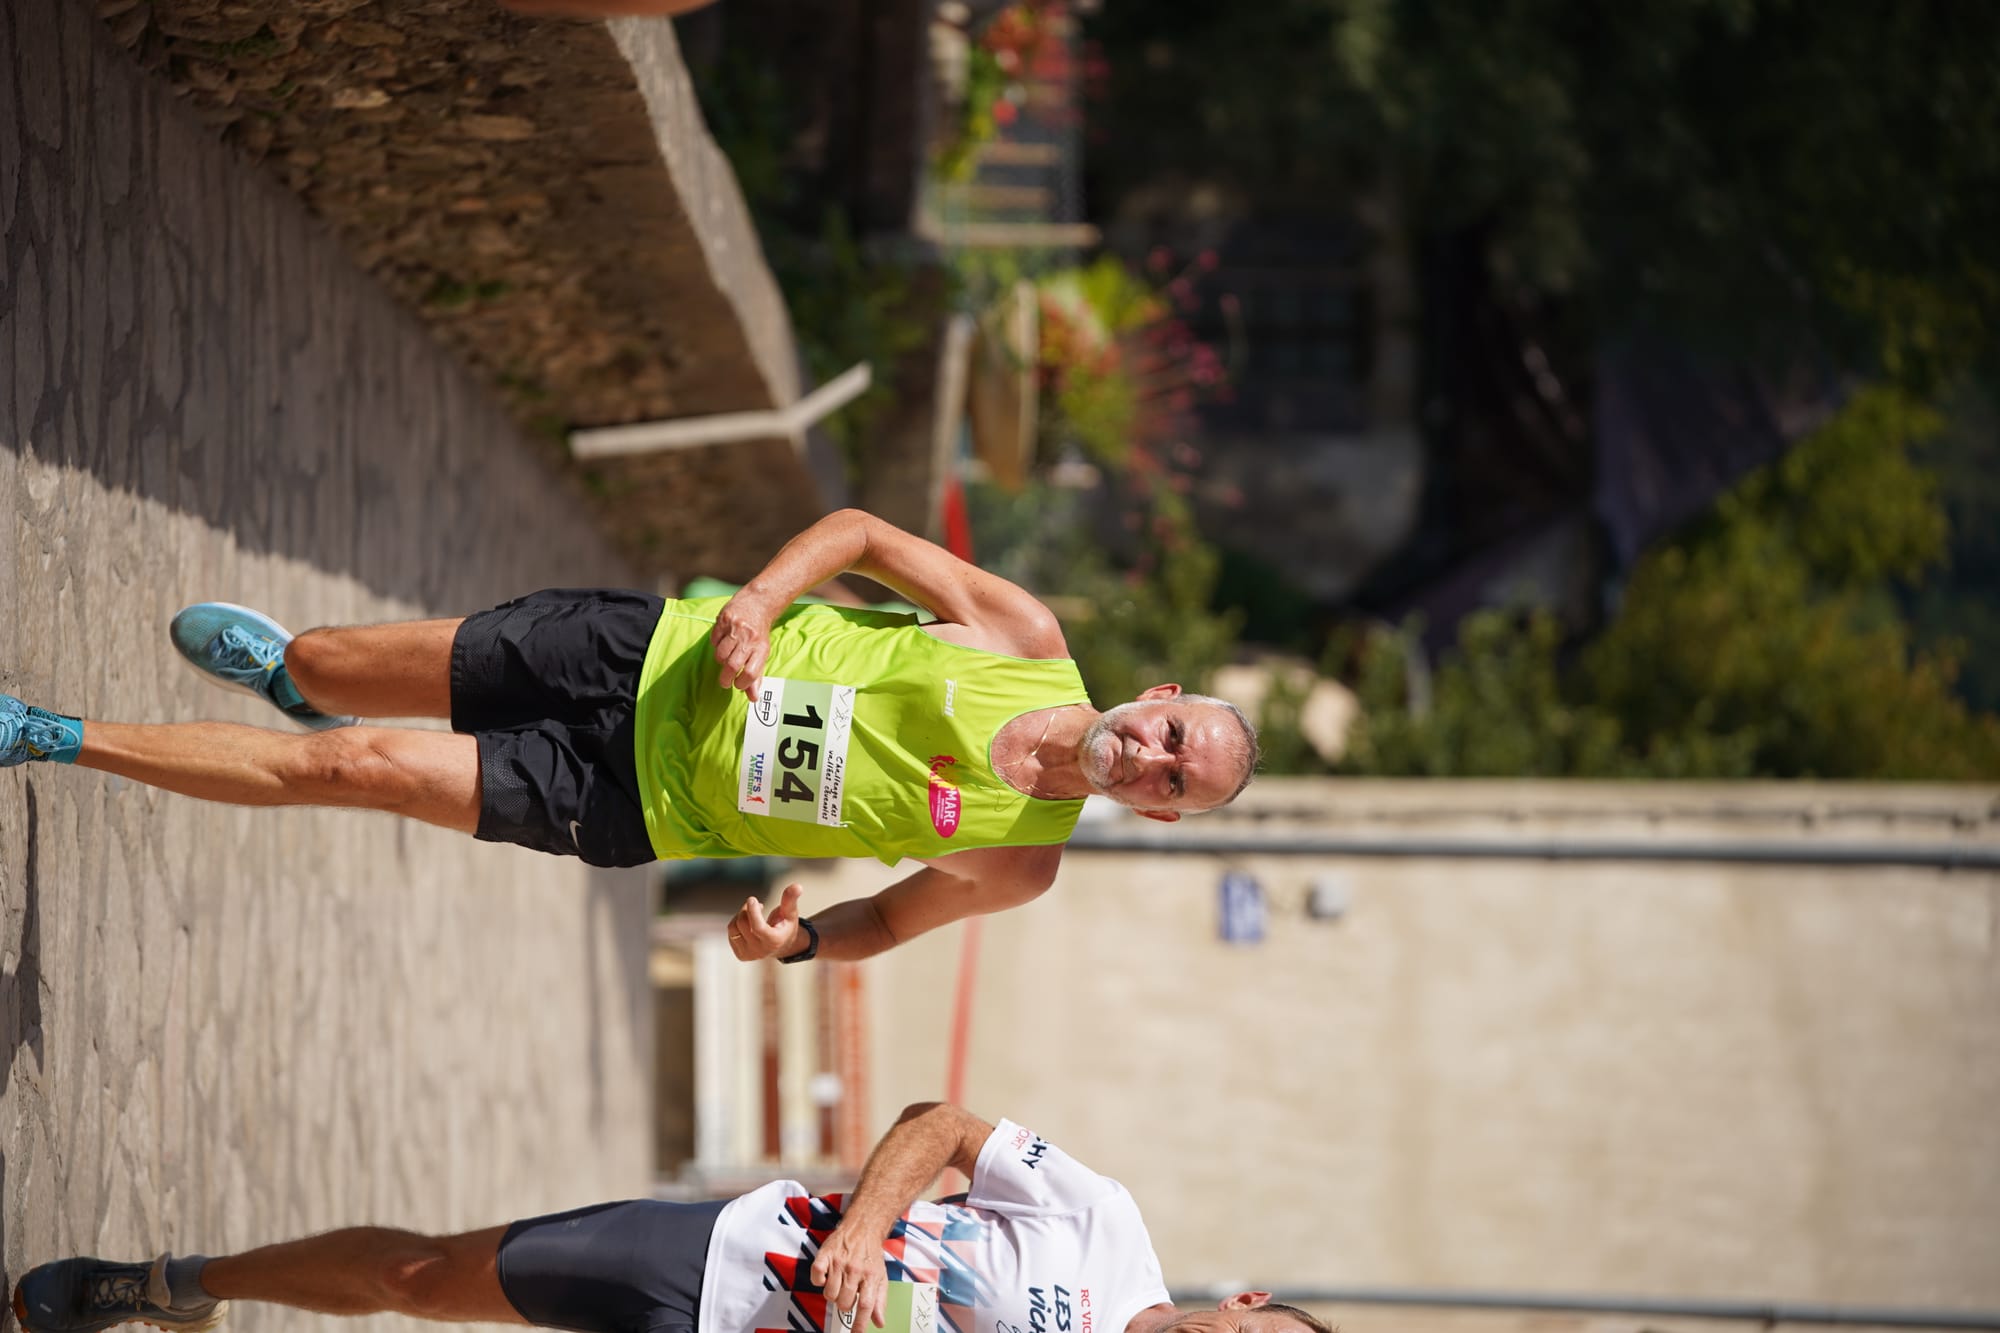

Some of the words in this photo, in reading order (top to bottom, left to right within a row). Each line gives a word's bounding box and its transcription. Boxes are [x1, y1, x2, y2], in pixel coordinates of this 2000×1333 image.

[761, 690, 773, 721] BFP
[752, 752, 765, 793] TUFF'S
[774, 703, 823, 804] 154
[830, 756, 844, 799] Challenge
[831, 804, 839, 818] des
[943, 790, 958, 827] MARC
[1054, 1284, 1071, 1332] LES
[1080, 1288, 1090, 1307] RC
